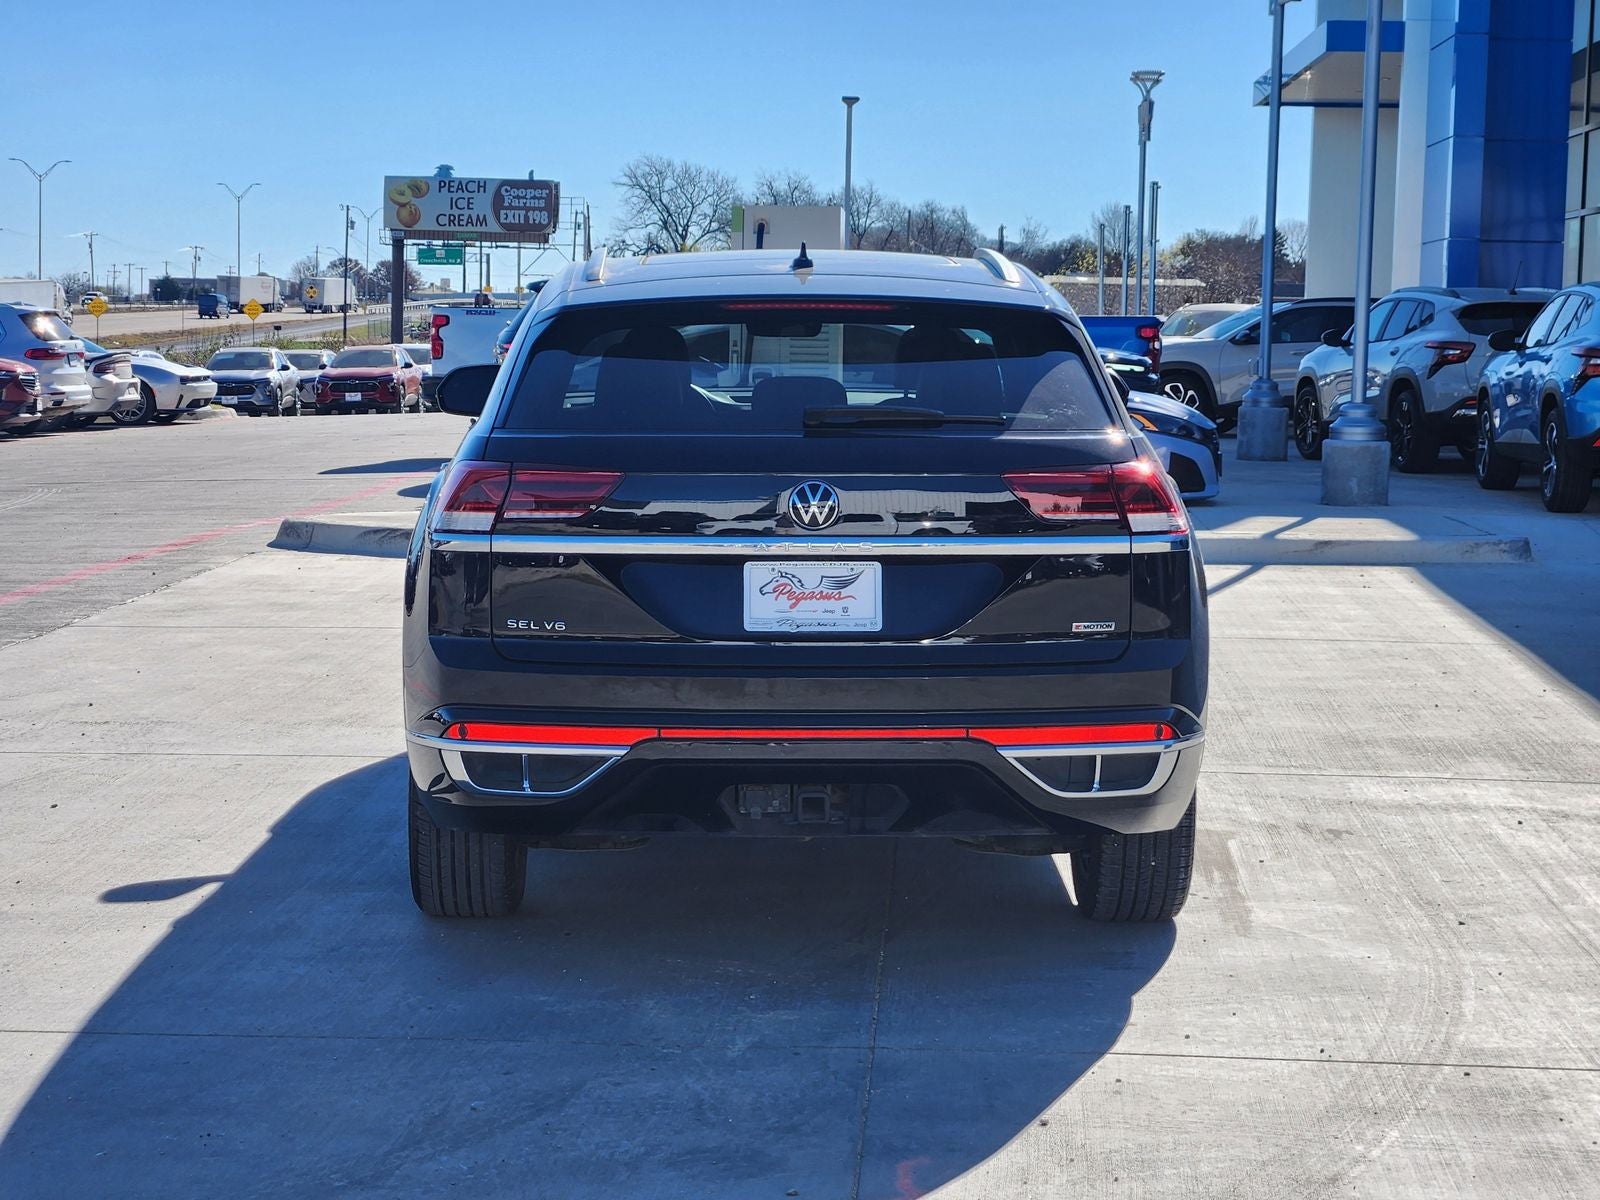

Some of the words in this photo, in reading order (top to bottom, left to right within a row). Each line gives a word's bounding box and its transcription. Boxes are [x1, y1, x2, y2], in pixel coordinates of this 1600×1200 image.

[438, 180, 487, 194] PEACH
[501, 186, 549, 199] Cooper
[450, 196, 475, 211] ICE
[503, 196, 546, 207] Farms
[435, 213, 488, 228] CREAM
[500, 209, 526, 224] EXIT
[528, 210, 549, 225] 198
[754, 541, 873, 552] ATLAS
[772, 582, 857, 610] Pegasus
[507, 619, 540, 631] SEL
[543, 620, 566, 631] V6
